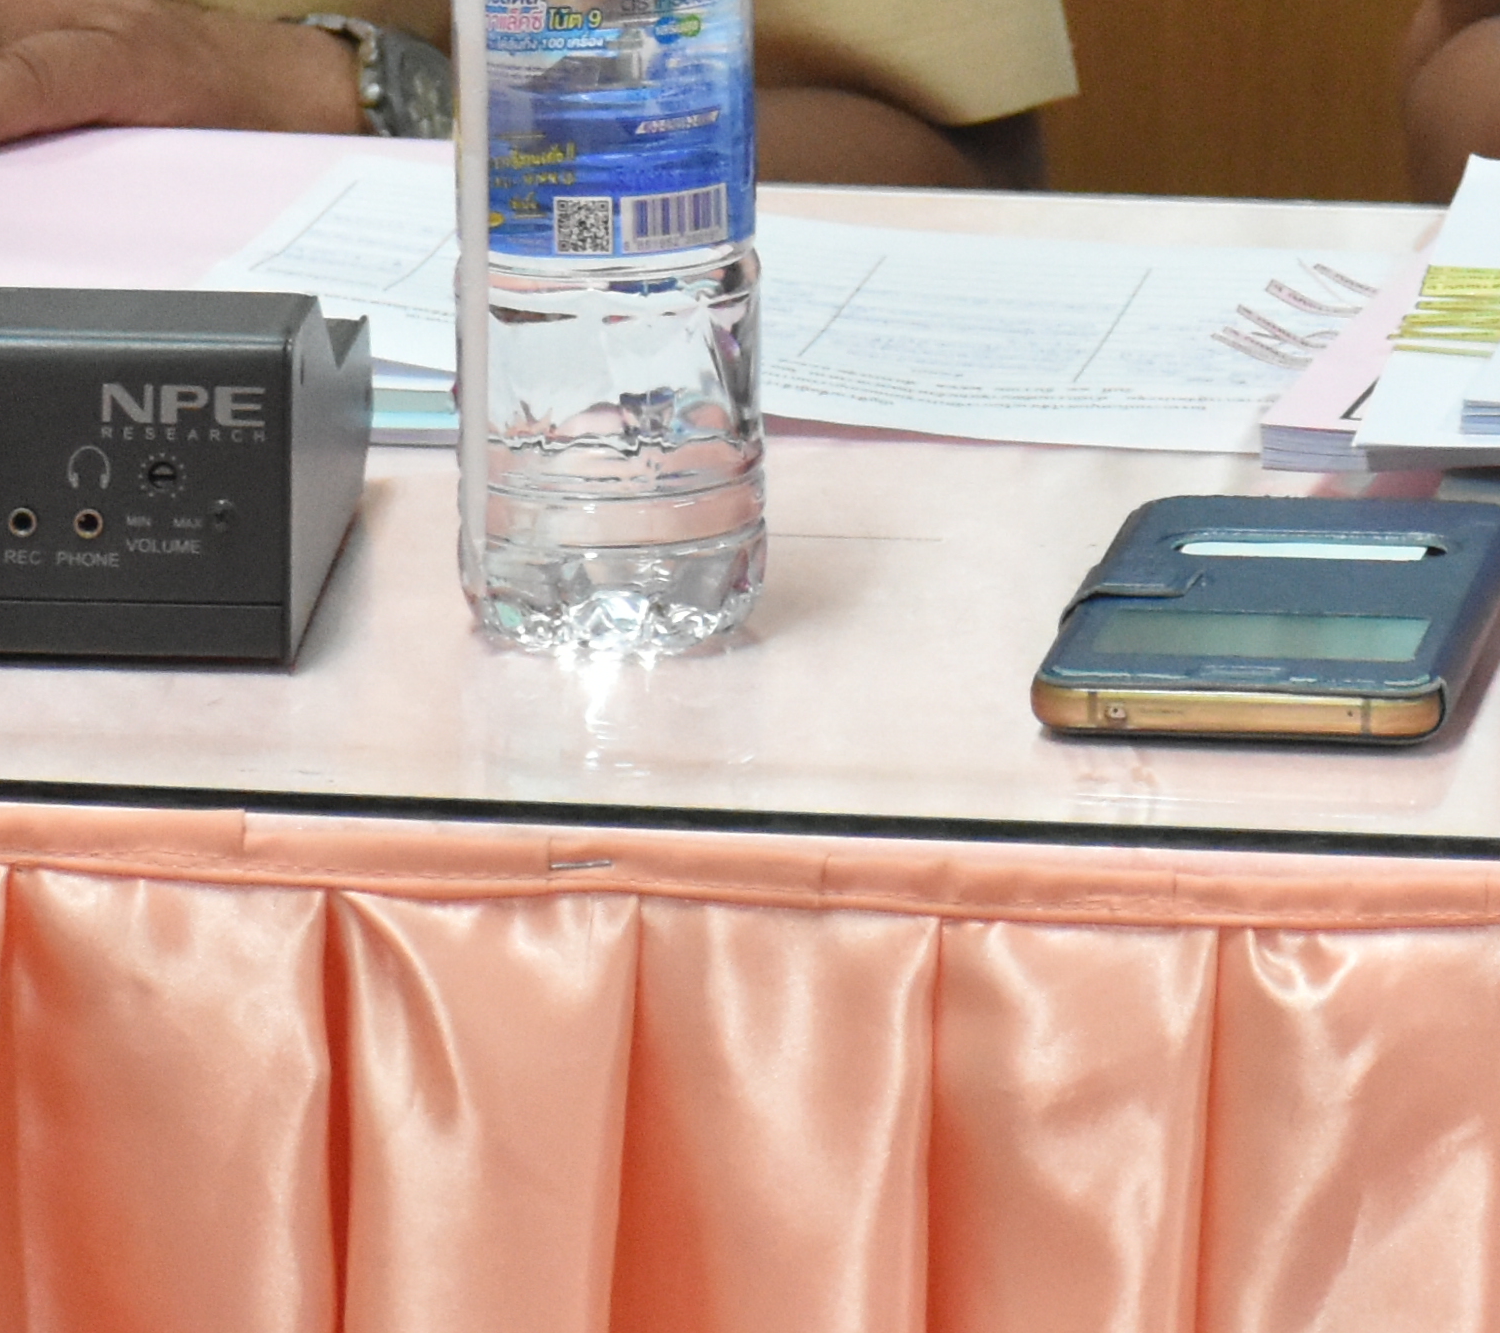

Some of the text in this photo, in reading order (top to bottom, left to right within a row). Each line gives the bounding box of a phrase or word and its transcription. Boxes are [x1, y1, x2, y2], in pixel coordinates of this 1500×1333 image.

[587, 7, 602, 30] 9
[101, 382, 267, 428] NPE
[101, 427, 267, 443] RESEARCH
[126, 515, 203, 529] MIN MAX
[126, 538, 202, 555] VOLUME
[4, 549, 121, 569] REC PHONE
